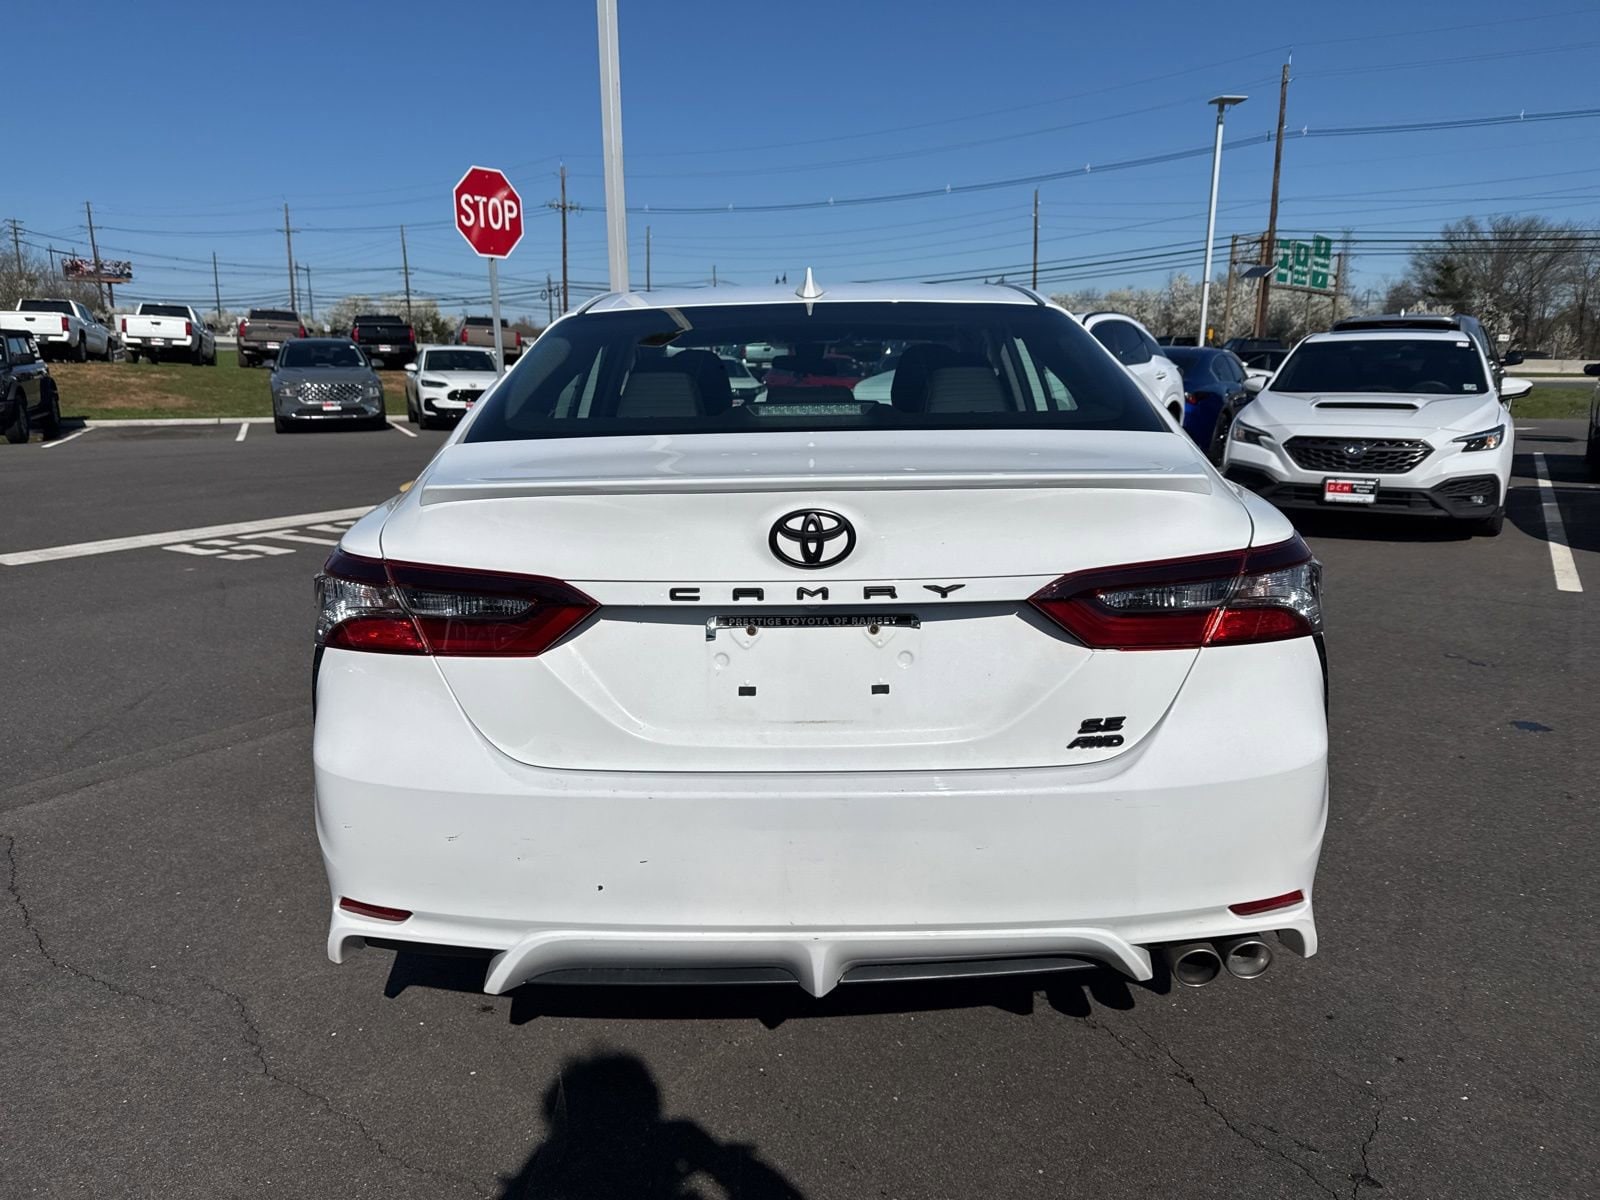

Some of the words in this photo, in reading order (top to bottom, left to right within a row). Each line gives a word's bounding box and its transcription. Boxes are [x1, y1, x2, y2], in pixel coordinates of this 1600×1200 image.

[460, 193, 518, 231] STOP
[669, 583, 966, 601] CAMRY
[728, 617, 781, 626] PRESTIGE
[785, 617, 830, 625] TOYOTA
[834, 617, 848, 625] OF
[851, 616, 898, 625] RAMSEY
[1077, 716, 1127, 734] SE
[1066, 734, 1125, 749] AWD
